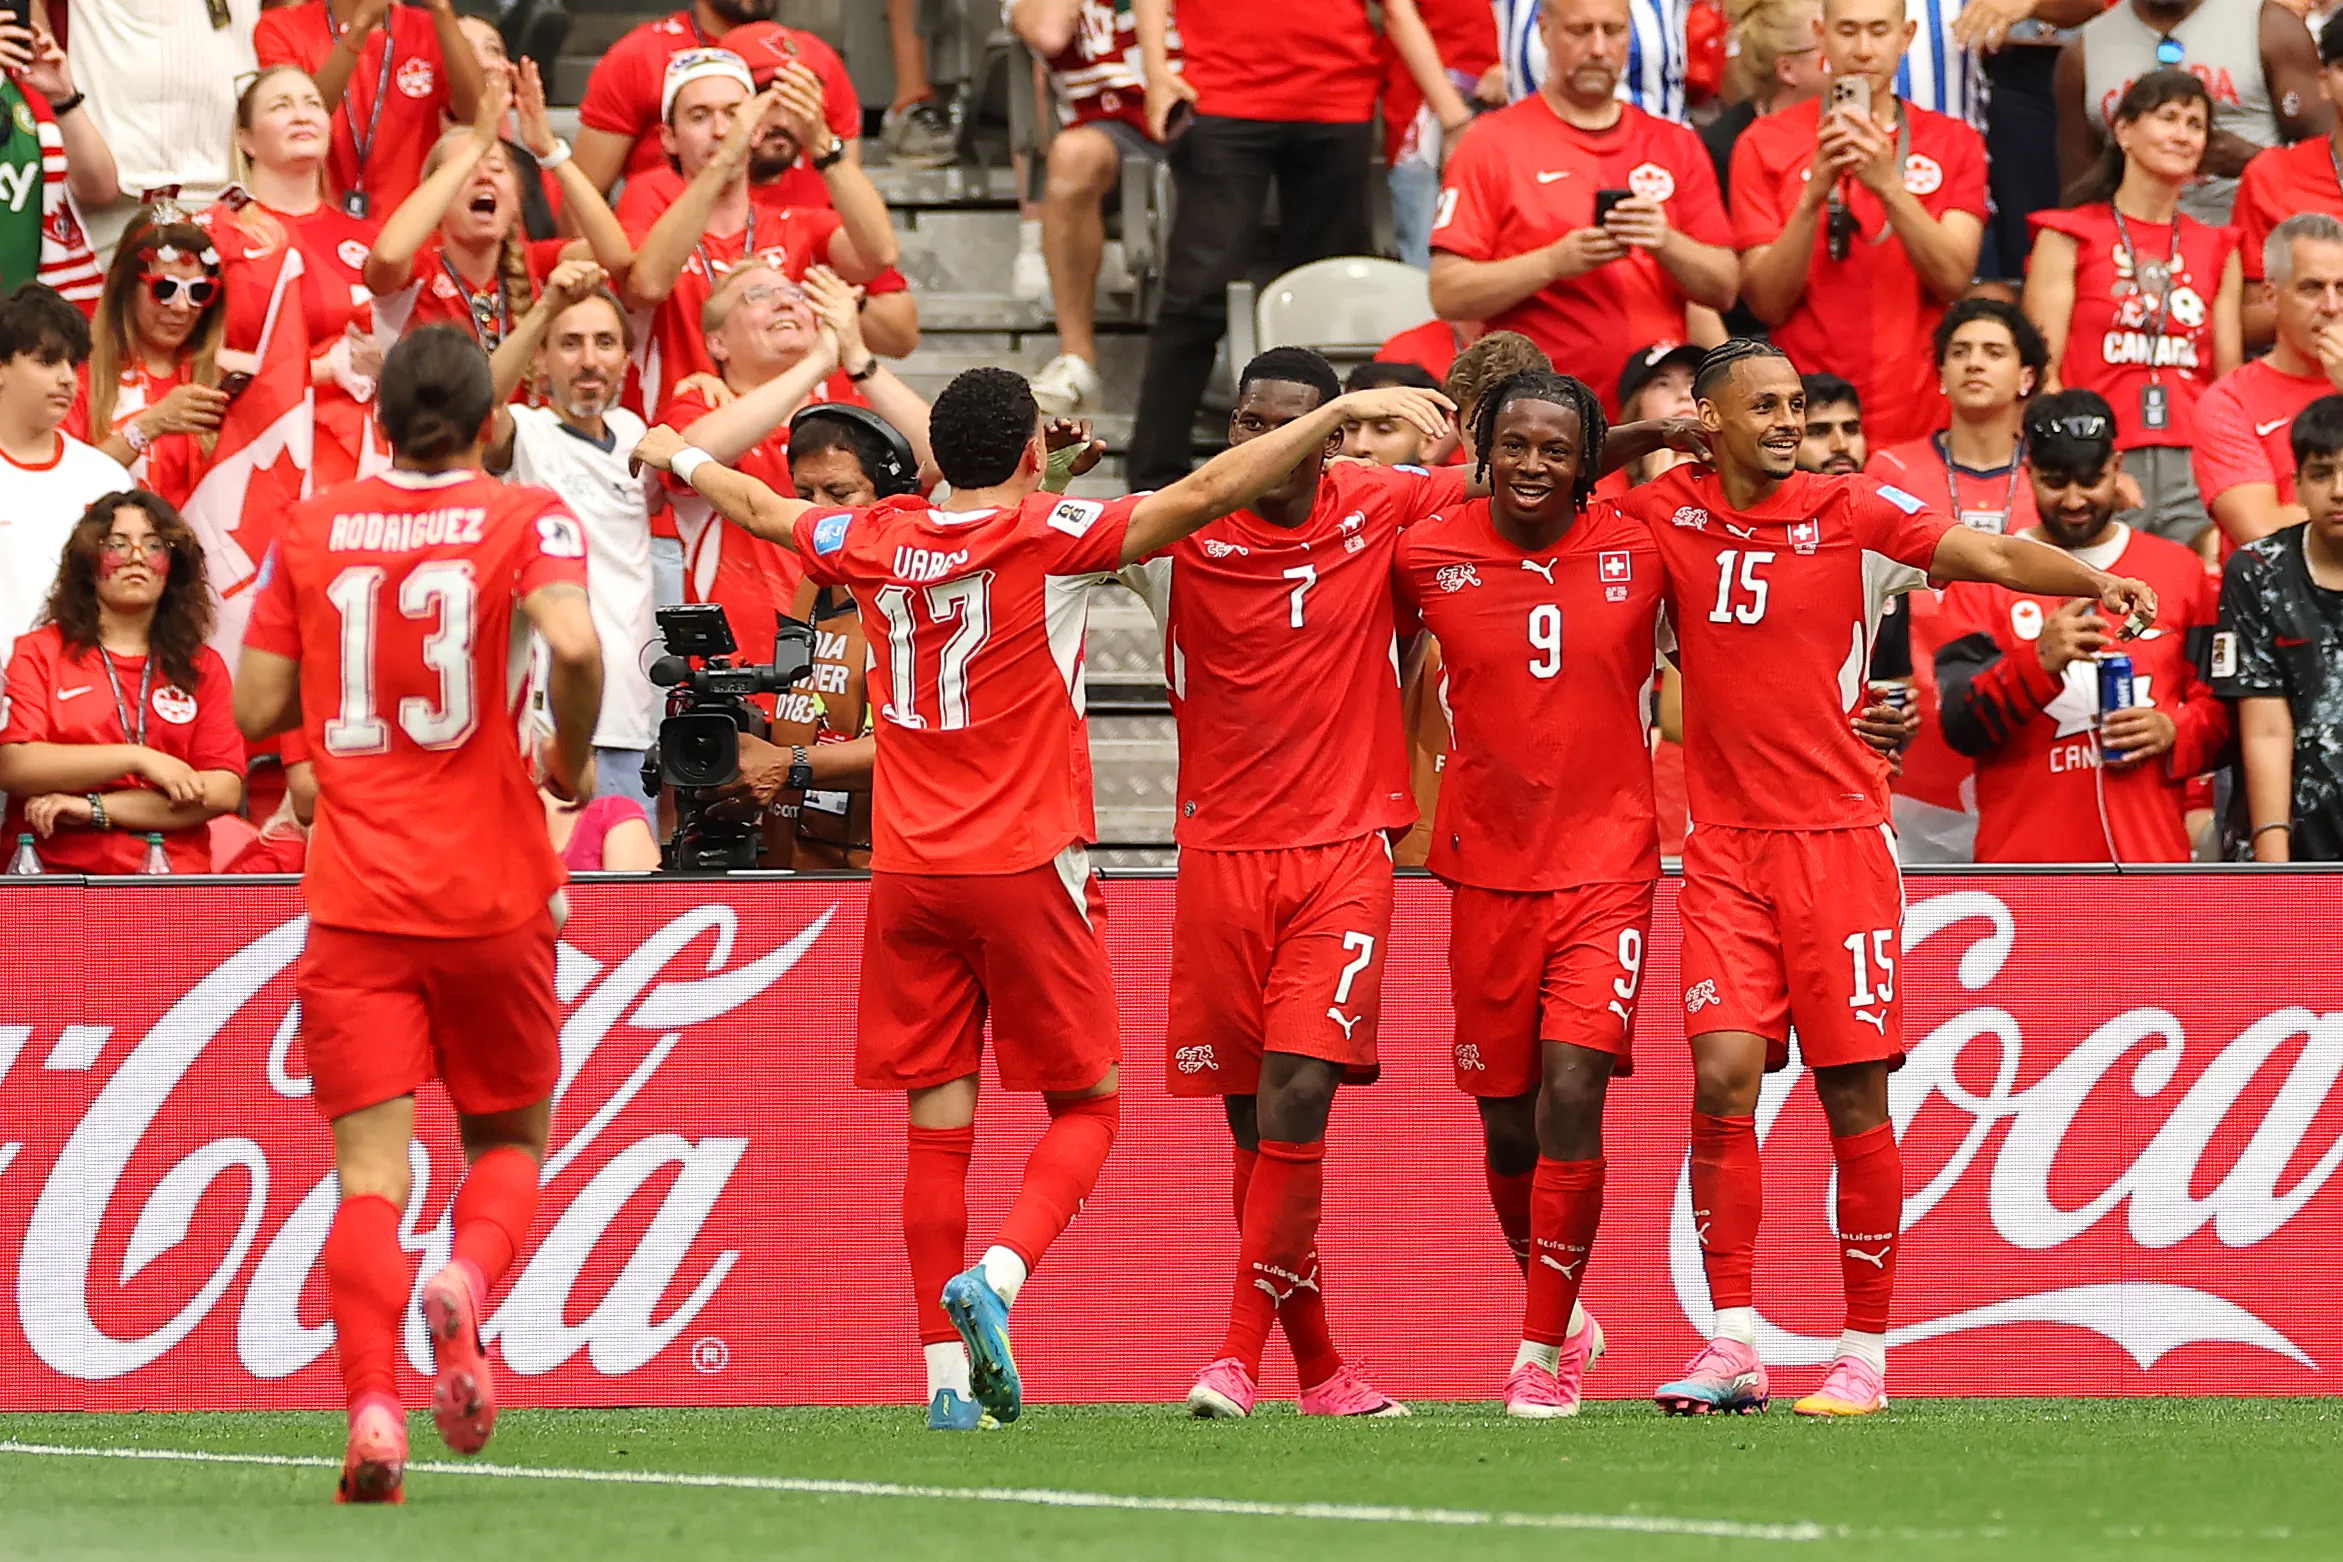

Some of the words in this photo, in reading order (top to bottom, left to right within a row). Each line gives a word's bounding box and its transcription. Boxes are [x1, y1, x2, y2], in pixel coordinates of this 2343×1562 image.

[0, 162, 38, 212] y
[329, 507, 486, 552] RODRIGUEZ
[1282, 563, 1317, 629] 7
[1708, 549, 1776, 625] 15
[325, 559, 479, 757] 13
[874, 569, 996, 731] 17
[1528, 603, 1562, 679] 9
[776, 693, 816, 723] 0183
[2049, 744, 2102, 773] CAN
[1333, 930, 1375, 1004] 7
[1613, 927, 1642, 999] 9
[1843, 929, 1894, 1008] 15
[0, 900, 840, 1380] -Cola
